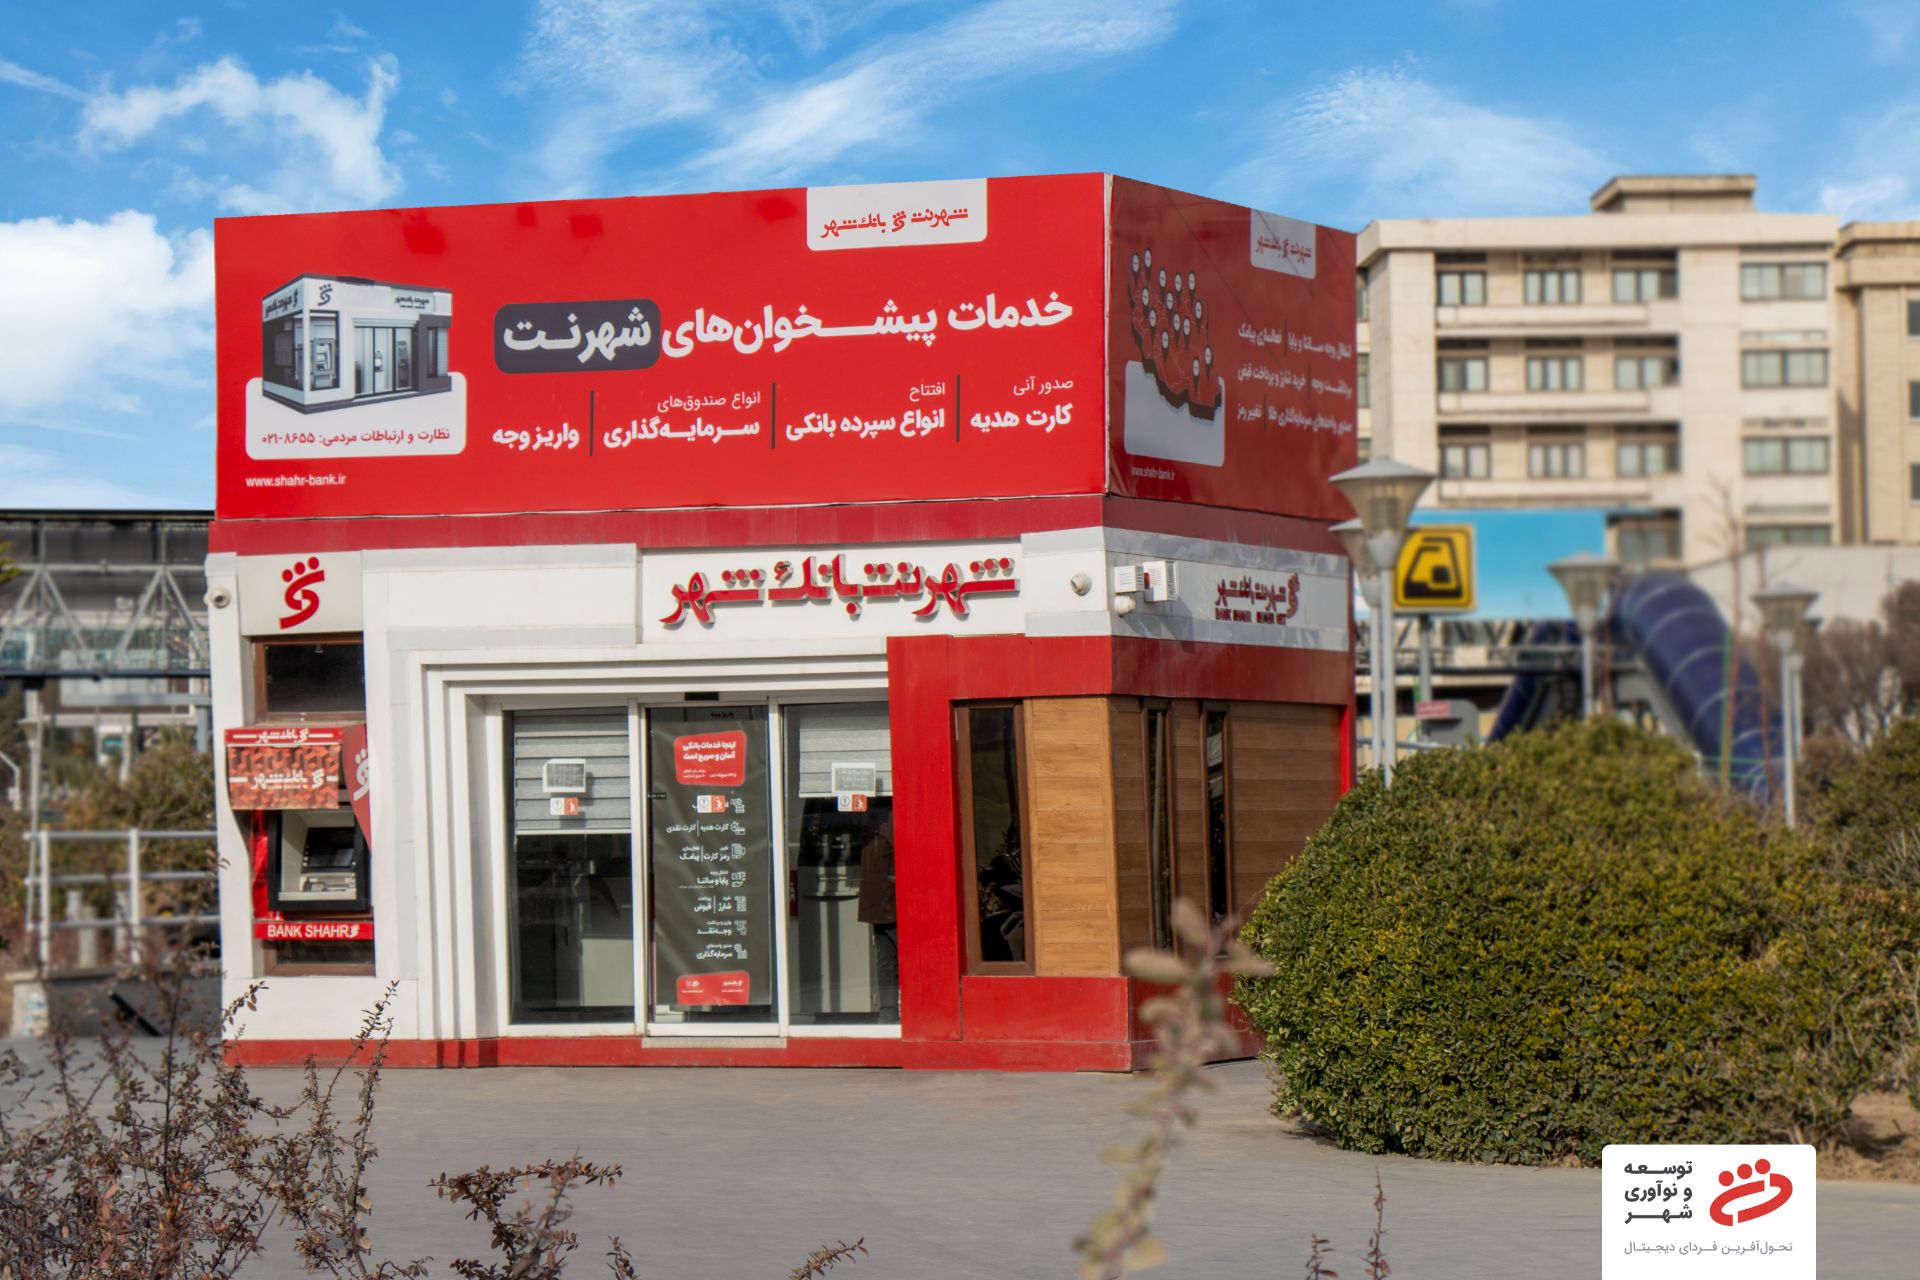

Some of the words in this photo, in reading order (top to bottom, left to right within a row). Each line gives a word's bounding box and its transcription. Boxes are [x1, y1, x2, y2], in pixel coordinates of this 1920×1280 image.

[911, 208, 968, 227] شهرنت
[820, 219, 857, 238] شهر
[947, 291, 1073, 331] خدمات
[503, 306, 651, 363] شهرنت
[909, 382, 946, 401] افتتاح
[1013, 376, 1035, 396] آنی
[1038, 378, 1074, 396] صدور
[731, 391, 761, 406] انواع
[899, 408, 945, 436] انواع
[970, 407, 1020, 433] هدیه
[1026, 403, 1073, 433] کارت
[786, 412, 837, 441] بانکی
[840, 416, 896, 440] سپرده
[319, 431, 357, 446] مردمی:
[361, 430, 403, 445] ارتباطات
[407, 434, 413, 444] و
[417, 428, 450, 445] نظارت
[492, 429, 531, 451] وجه
[532, 422, 580, 450] واریز
[245, 474, 347, 487] www.shahr-bank.ir
[863, 557, 1020, 618] شهرنت
[659, 568, 765, 626] شهر
[682, 742, 701, 751] بانکی
[701, 741, 721, 749] خدمات
[683, 752, 698, 760] است
[698, 753, 714, 762] سریع
[719, 751, 736, 760] آسان
[666, 824, 682, 833] نقدی
[682, 823, 696, 833] کارت
[700, 824, 714, 832] هدیه
[715, 823, 729, 832] کارت
[703, 852, 719, 862] کارت
[720, 853, 730, 862] رمز
[718, 902, 732, 912] شارژ
[267, 924, 302, 938] BANK
[304, 924, 350, 938] SHAHR
